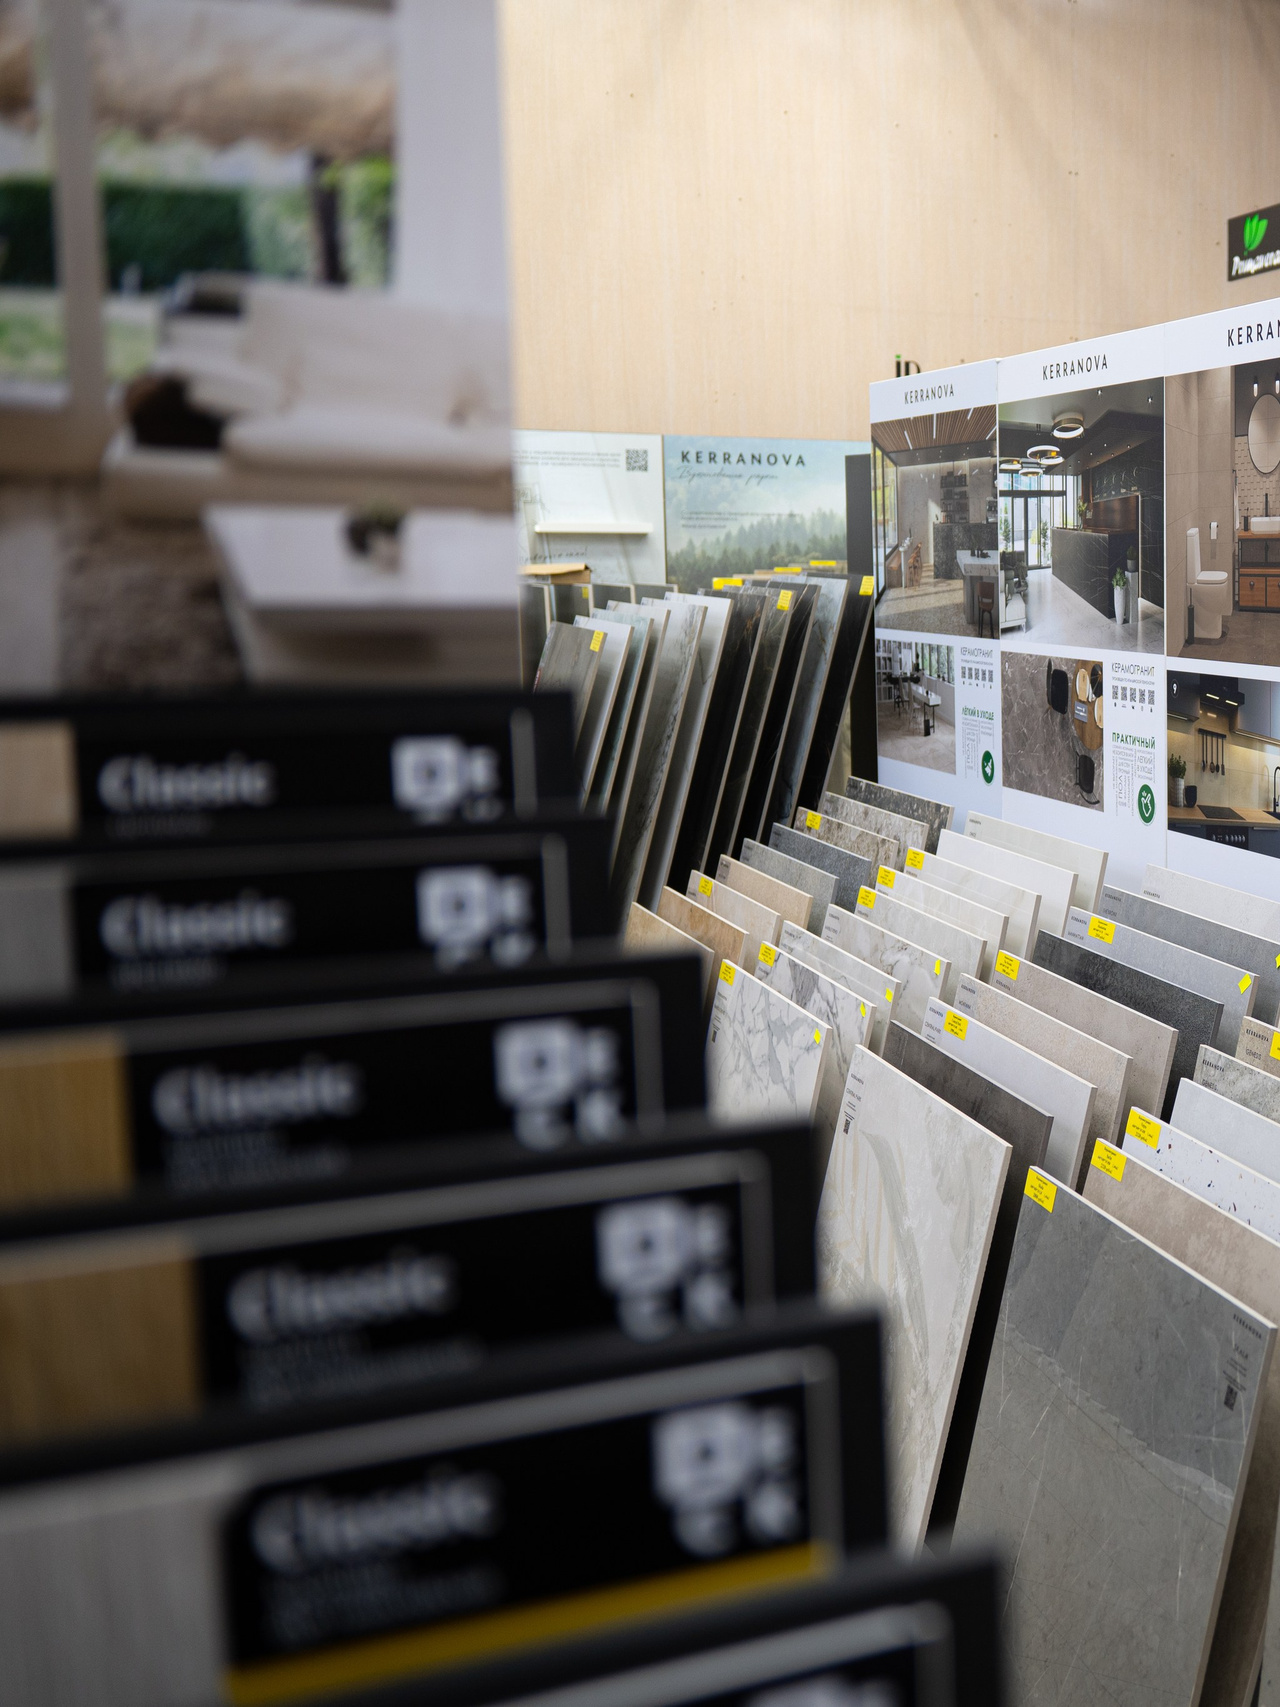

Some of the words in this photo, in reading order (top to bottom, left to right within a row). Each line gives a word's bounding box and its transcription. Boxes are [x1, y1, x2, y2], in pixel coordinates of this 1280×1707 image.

[1042, 354, 1108, 380] KERRANOVA
[904, 383, 954, 404] KERRANOVA
[681, 450, 806, 467] KERRANOVA
[960, 647, 993, 659] КЕРАМОГРАНИТ
[1112, 662, 1154, 677] КЕРАМОГРАНИТ
[1112, 732, 1156, 749] ПРАКТИЧНЫЙ
[1246, 1028, 1269, 1042] KERRANOVA
[1246, 1048, 1261, 1060] GENESIS
